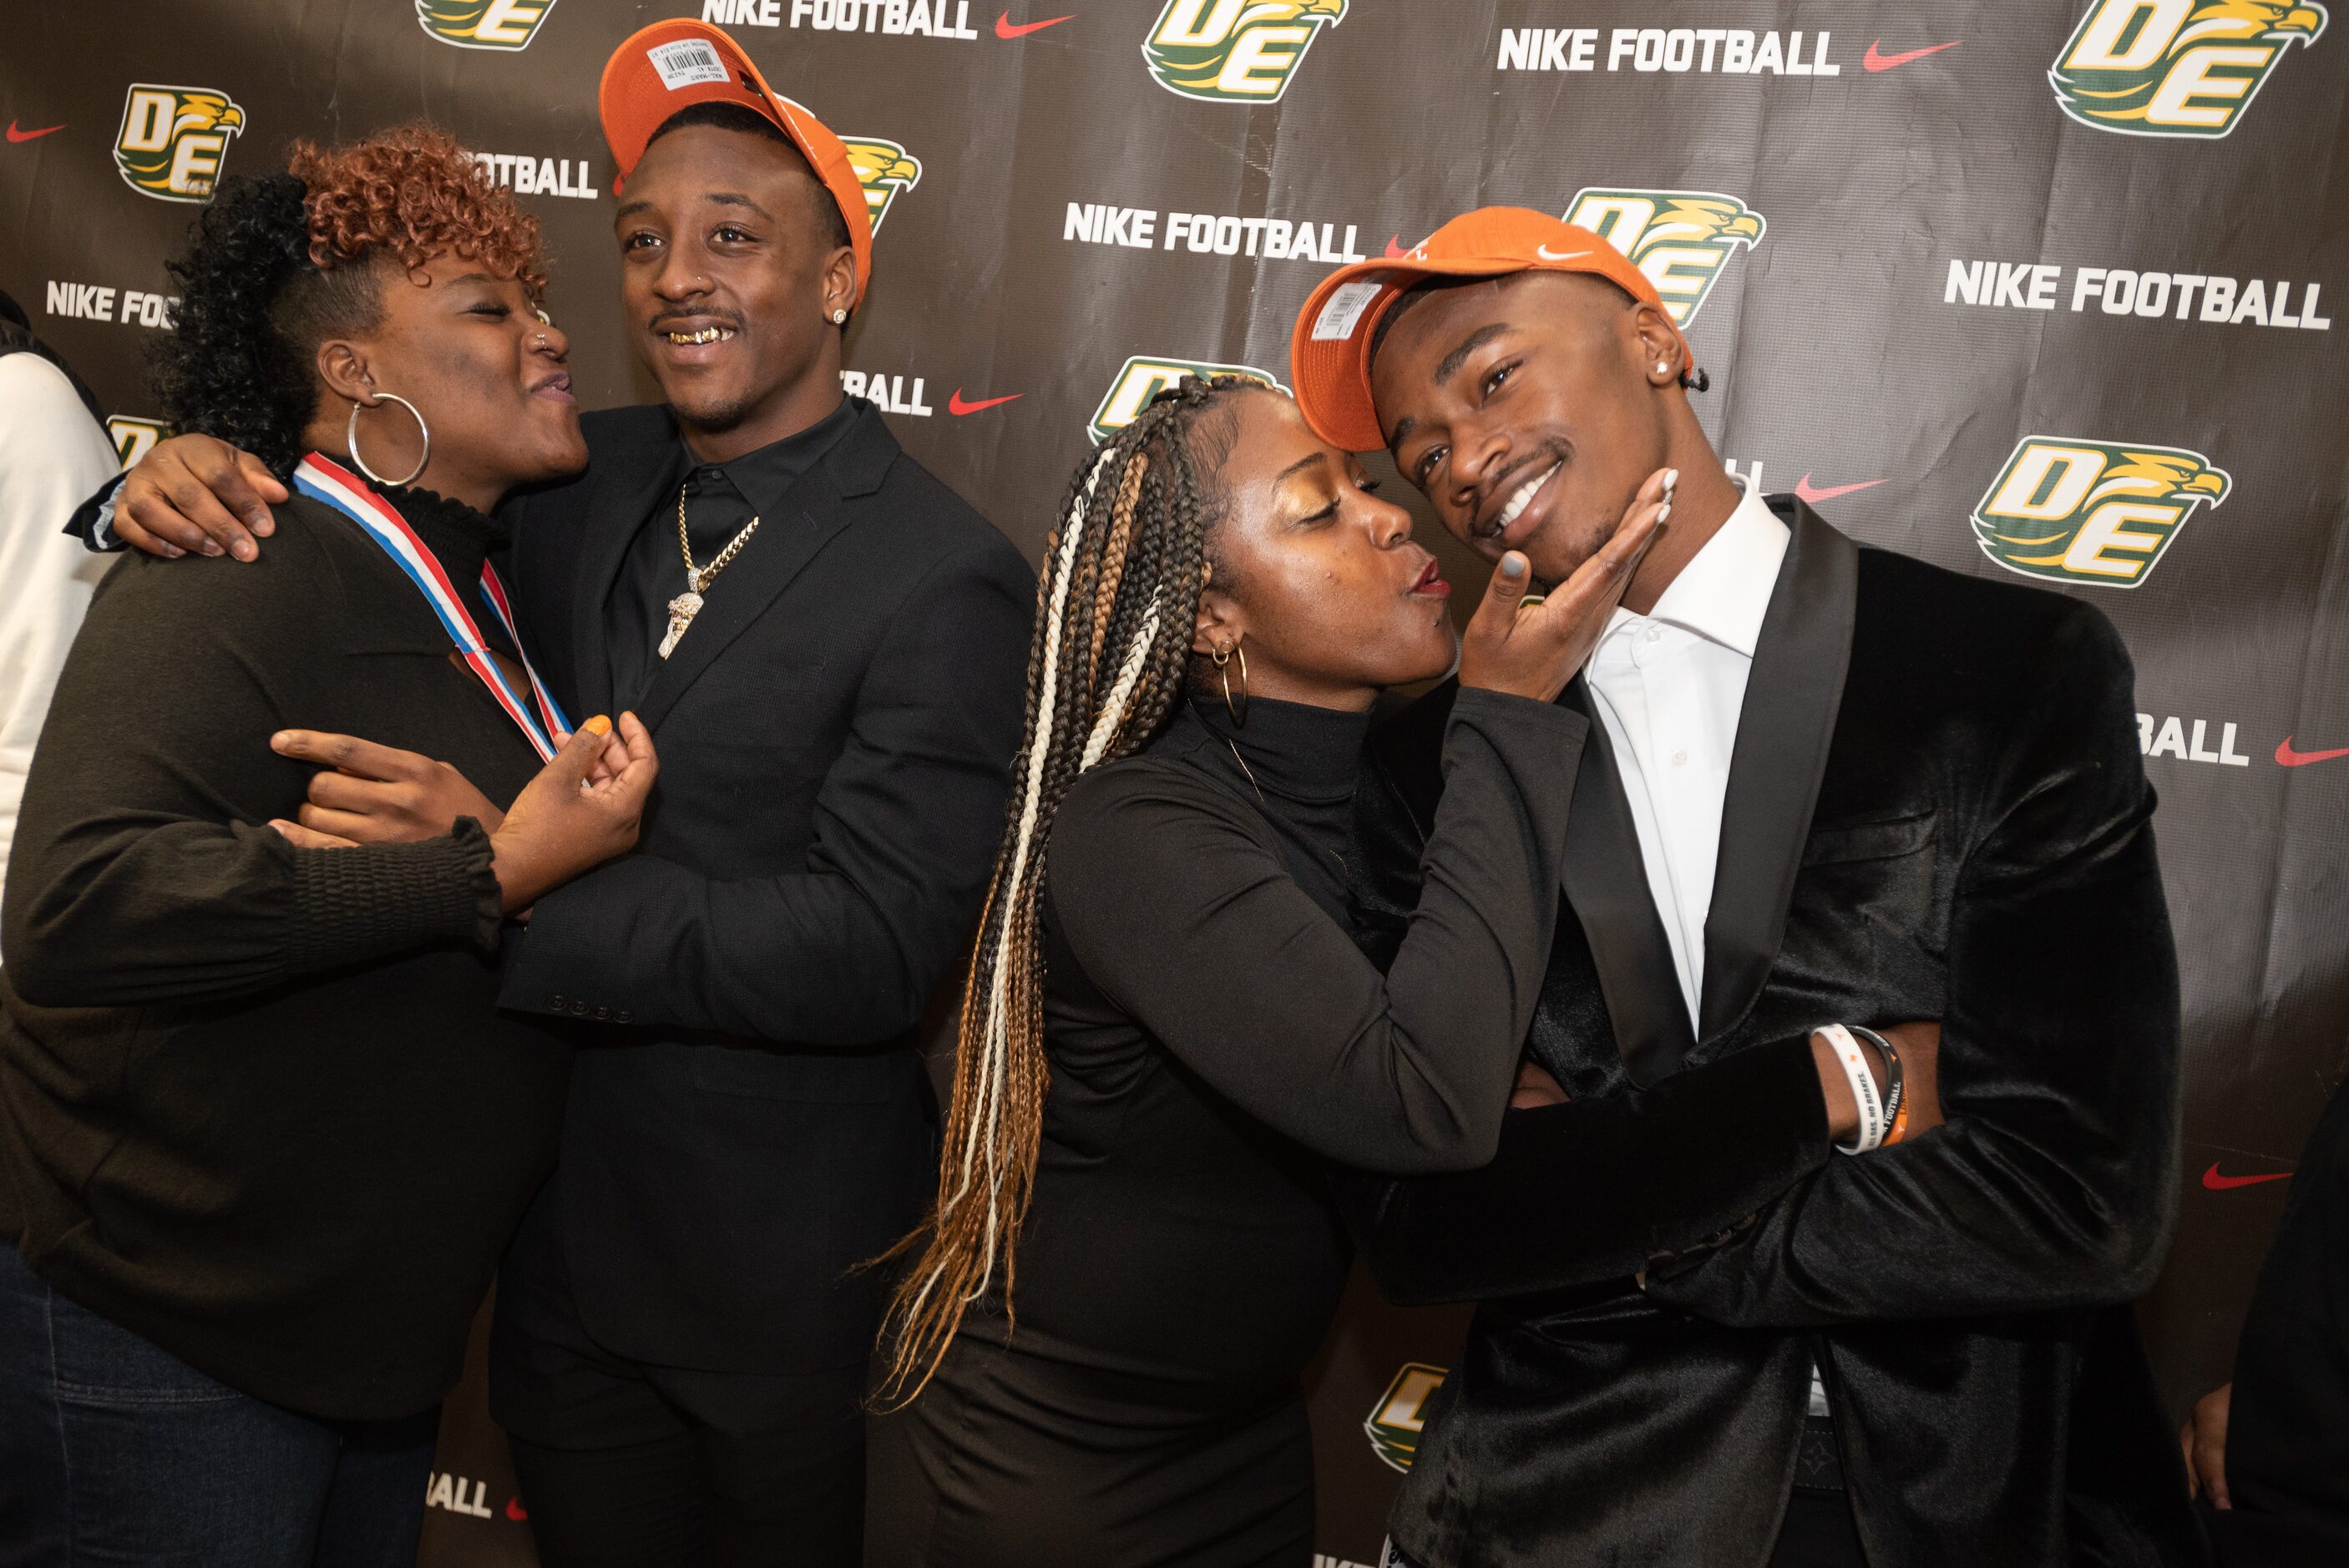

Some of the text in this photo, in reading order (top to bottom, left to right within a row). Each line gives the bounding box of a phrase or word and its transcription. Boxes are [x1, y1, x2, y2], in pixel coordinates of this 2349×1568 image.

[701, 0, 978, 40] NIKE FOOTBALL
[1496, 28, 1840, 76] NIKE FOOTBALL
[1063, 202, 1366, 265] NIKE FOOTBALL
[46, 280, 116, 321] NIKE
[1943, 259, 2331, 330] NIKE FOOTBALL
[839, 370, 933, 417] BALL
[1884, 1081, 1901, 1127] FOOTBALL
